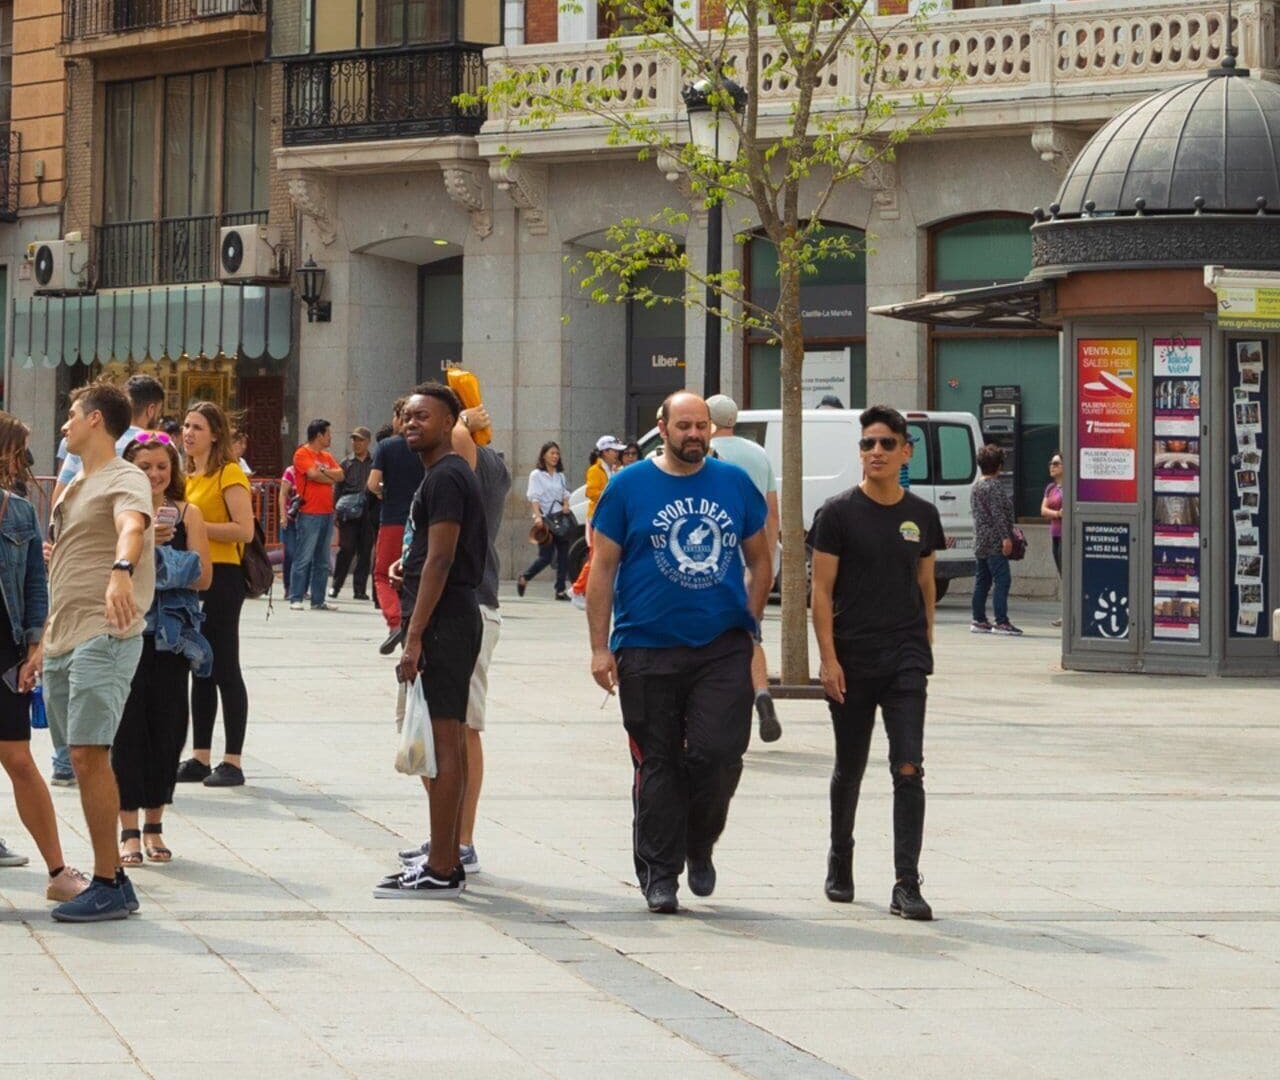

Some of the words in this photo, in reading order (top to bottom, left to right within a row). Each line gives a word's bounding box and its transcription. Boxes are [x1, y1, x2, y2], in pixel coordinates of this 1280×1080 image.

[1082, 346, 1110, 356] VENTA
[651, 354, 679, 368] Liber
[1082, 358, 1109, 368] SALES
[1110, 359, 1131, 368] HERE
[1085, 420, 1094, 434] 7
[1085, 525, 1128, 534] INFORMACIÓN
[650, 534, 667, 549] US
[722, 532, 737, 548] CO
